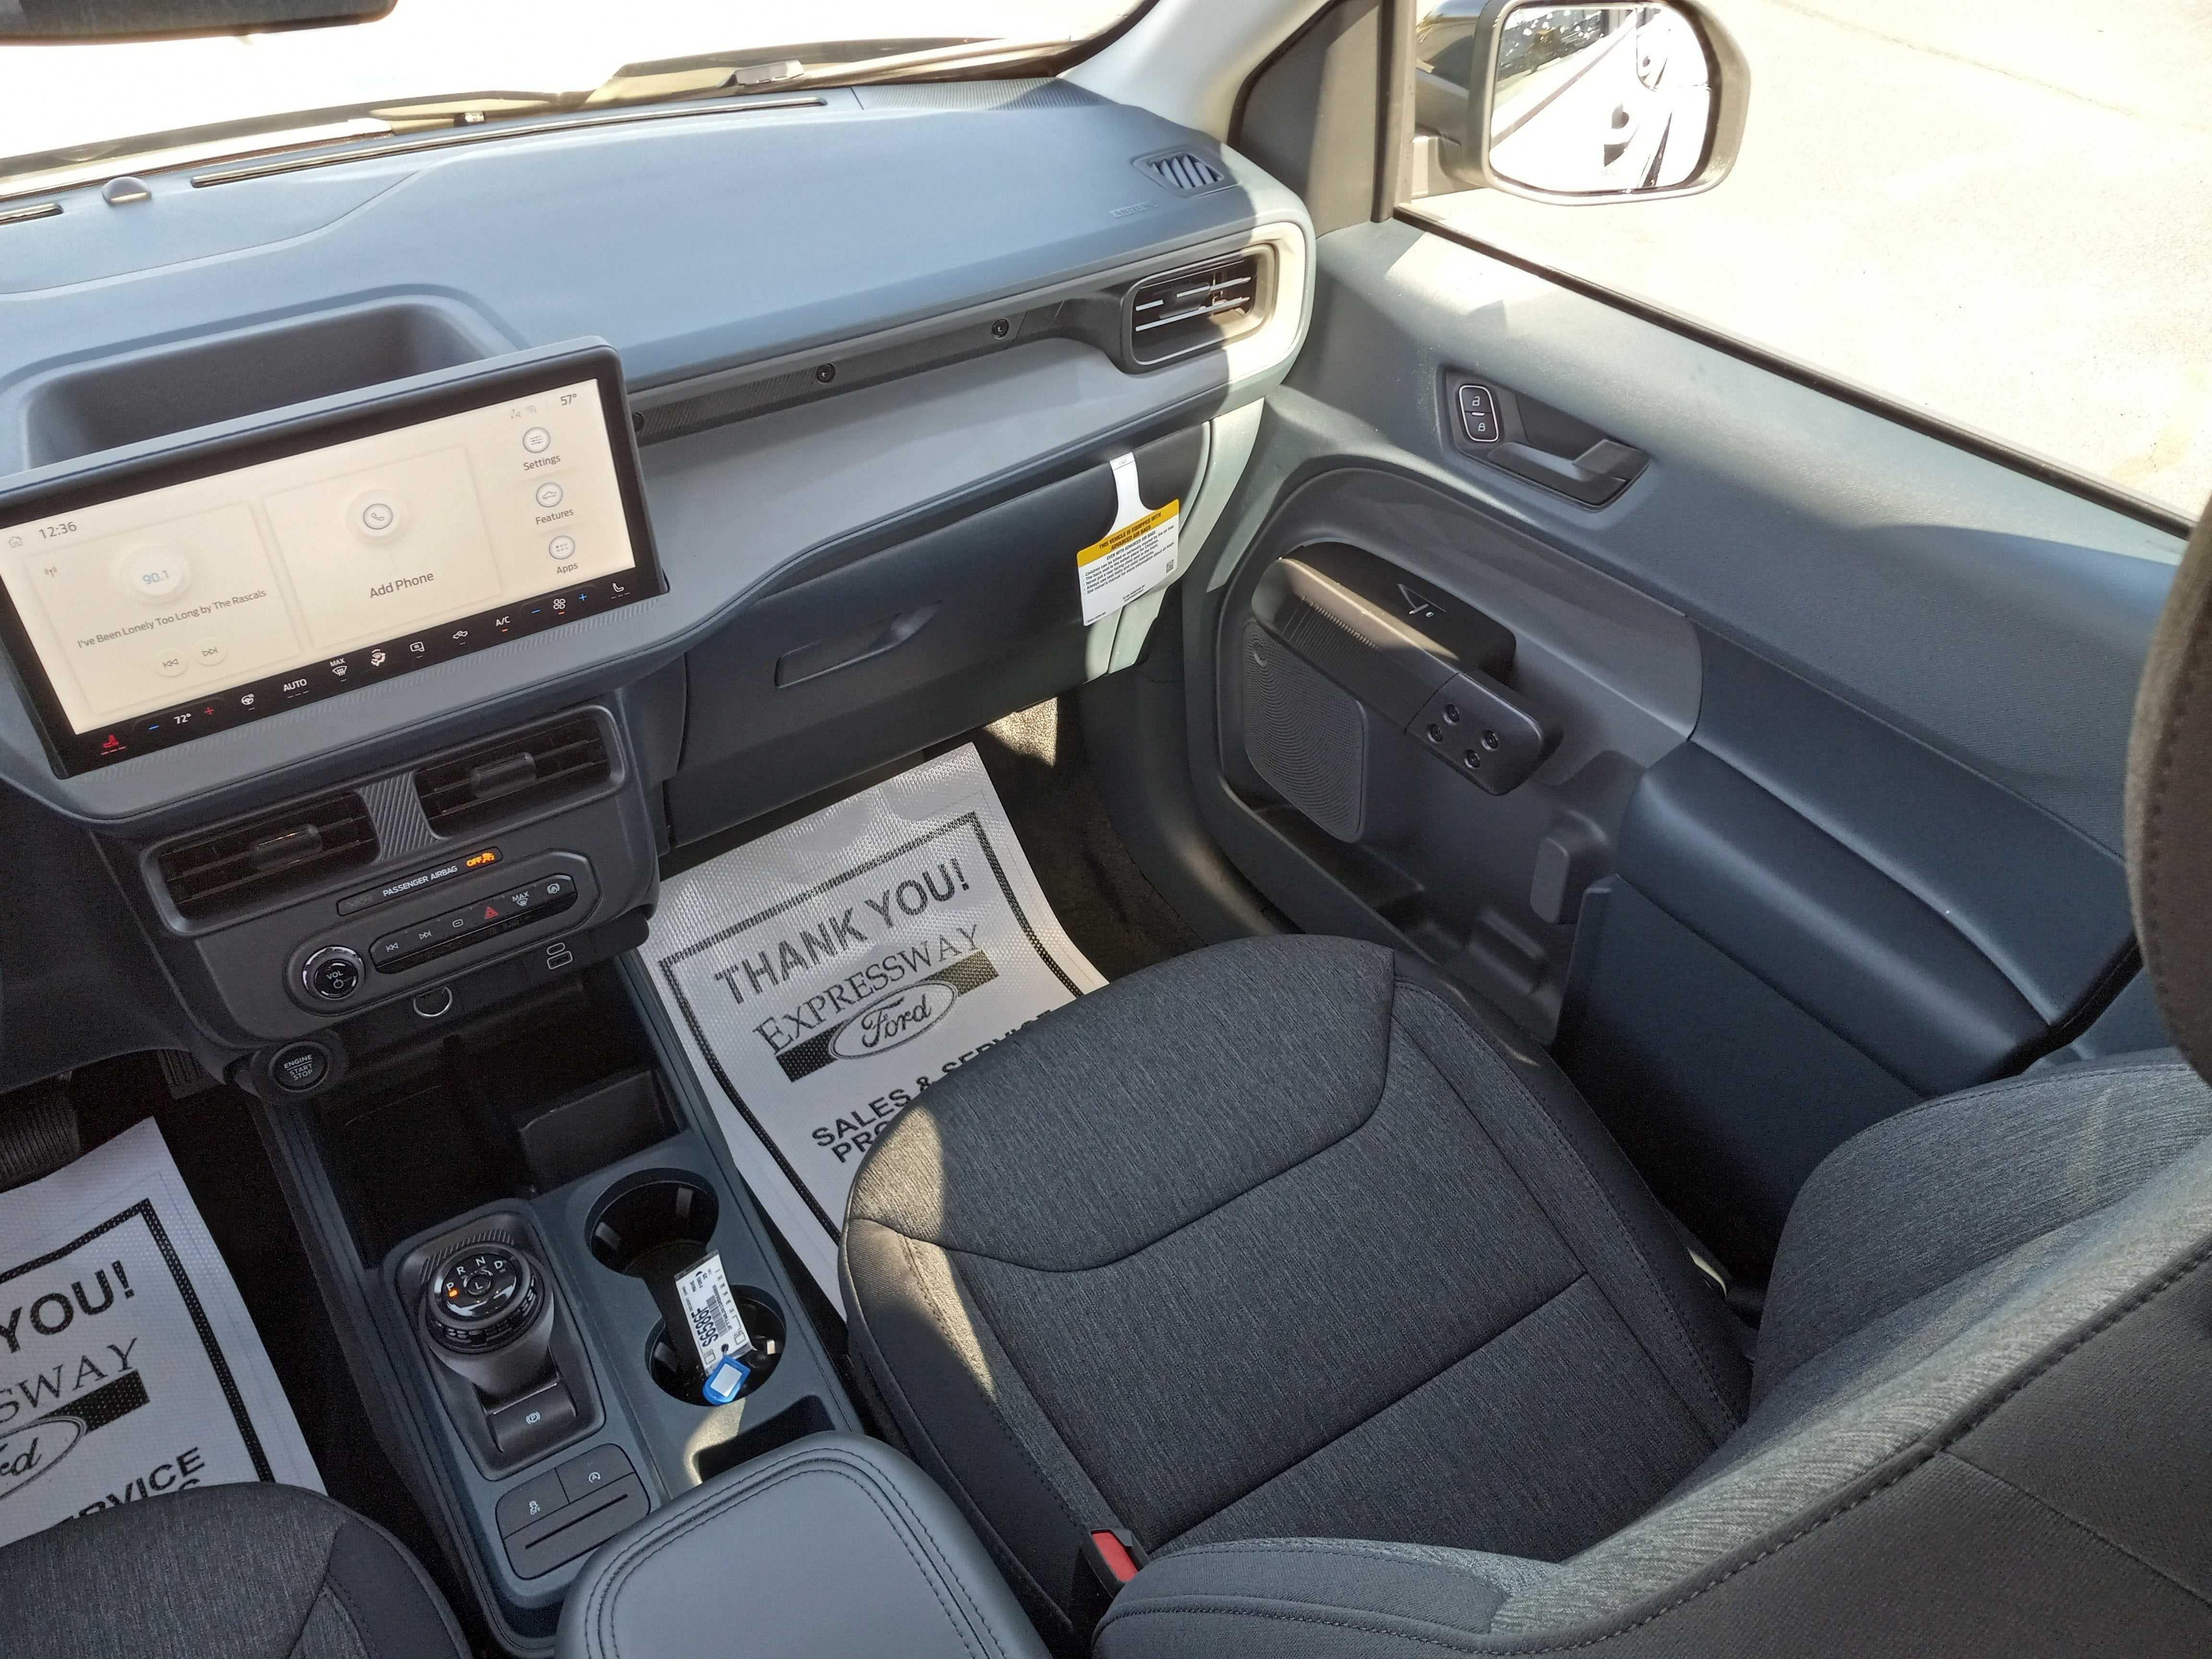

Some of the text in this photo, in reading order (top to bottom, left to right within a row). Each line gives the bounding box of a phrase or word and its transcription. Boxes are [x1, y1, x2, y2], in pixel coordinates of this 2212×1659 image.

[561, 393, 577, 406] 57°
[524, 456, 561, 470] Settings
[535, 509, 574, 525] Features
[39, 521, 77, 538] 12:36
[1099, 540, 1108, 550] THIS
[1109, 531, 1125, 544] VEHICLE
[1131, 518, 1150, 532] EQUIPPED
[1151, 512, 1161, 521] WITH
[1111, 535, 1132, 550] ADVANCED
[1141, 524, 1150, 534] BAGS
[556, 563, 578, 574] Apps
[143, 570, 169, 584] 90.1
[370, 573, 434, 598] Add Phone
[77, 589, 266, 648] I've Been Lonely Too Long by The Rascals
[496, 616, 510, 626] A/C
[330, 658, 346, 667] MAX
[283, 678, 307, 692] AUTO
[174, 713, 192, 724] 72°
[383, 875, 429, 897] PASSENGER
[431, 865, 458, 880] AIRBAG
[466, 856, 482, 866] OFF
[512, 891, 529, 902] MAX
[714, 857, 970, 1005] THANK YOU!
[326, 970, 344, 980] VOL
[861, 994, 932, 1048] Ford
[284, 1054, 313, 1069] ENGINE
[289, 1063, 313, 1076] START
[293, 1069, 313, 1080] STOP
[812, 1089, 912, 1147] SALES
[475, 1256, 486, 1266] N
[494, 1261, 503, 1269] D
[457, 1266, 466, 1275] R
[446, 1282, 454, 1291] P
[0, 1260, 134, 1354] YOU!
[691, 1306, 719, 1347] S6586F
